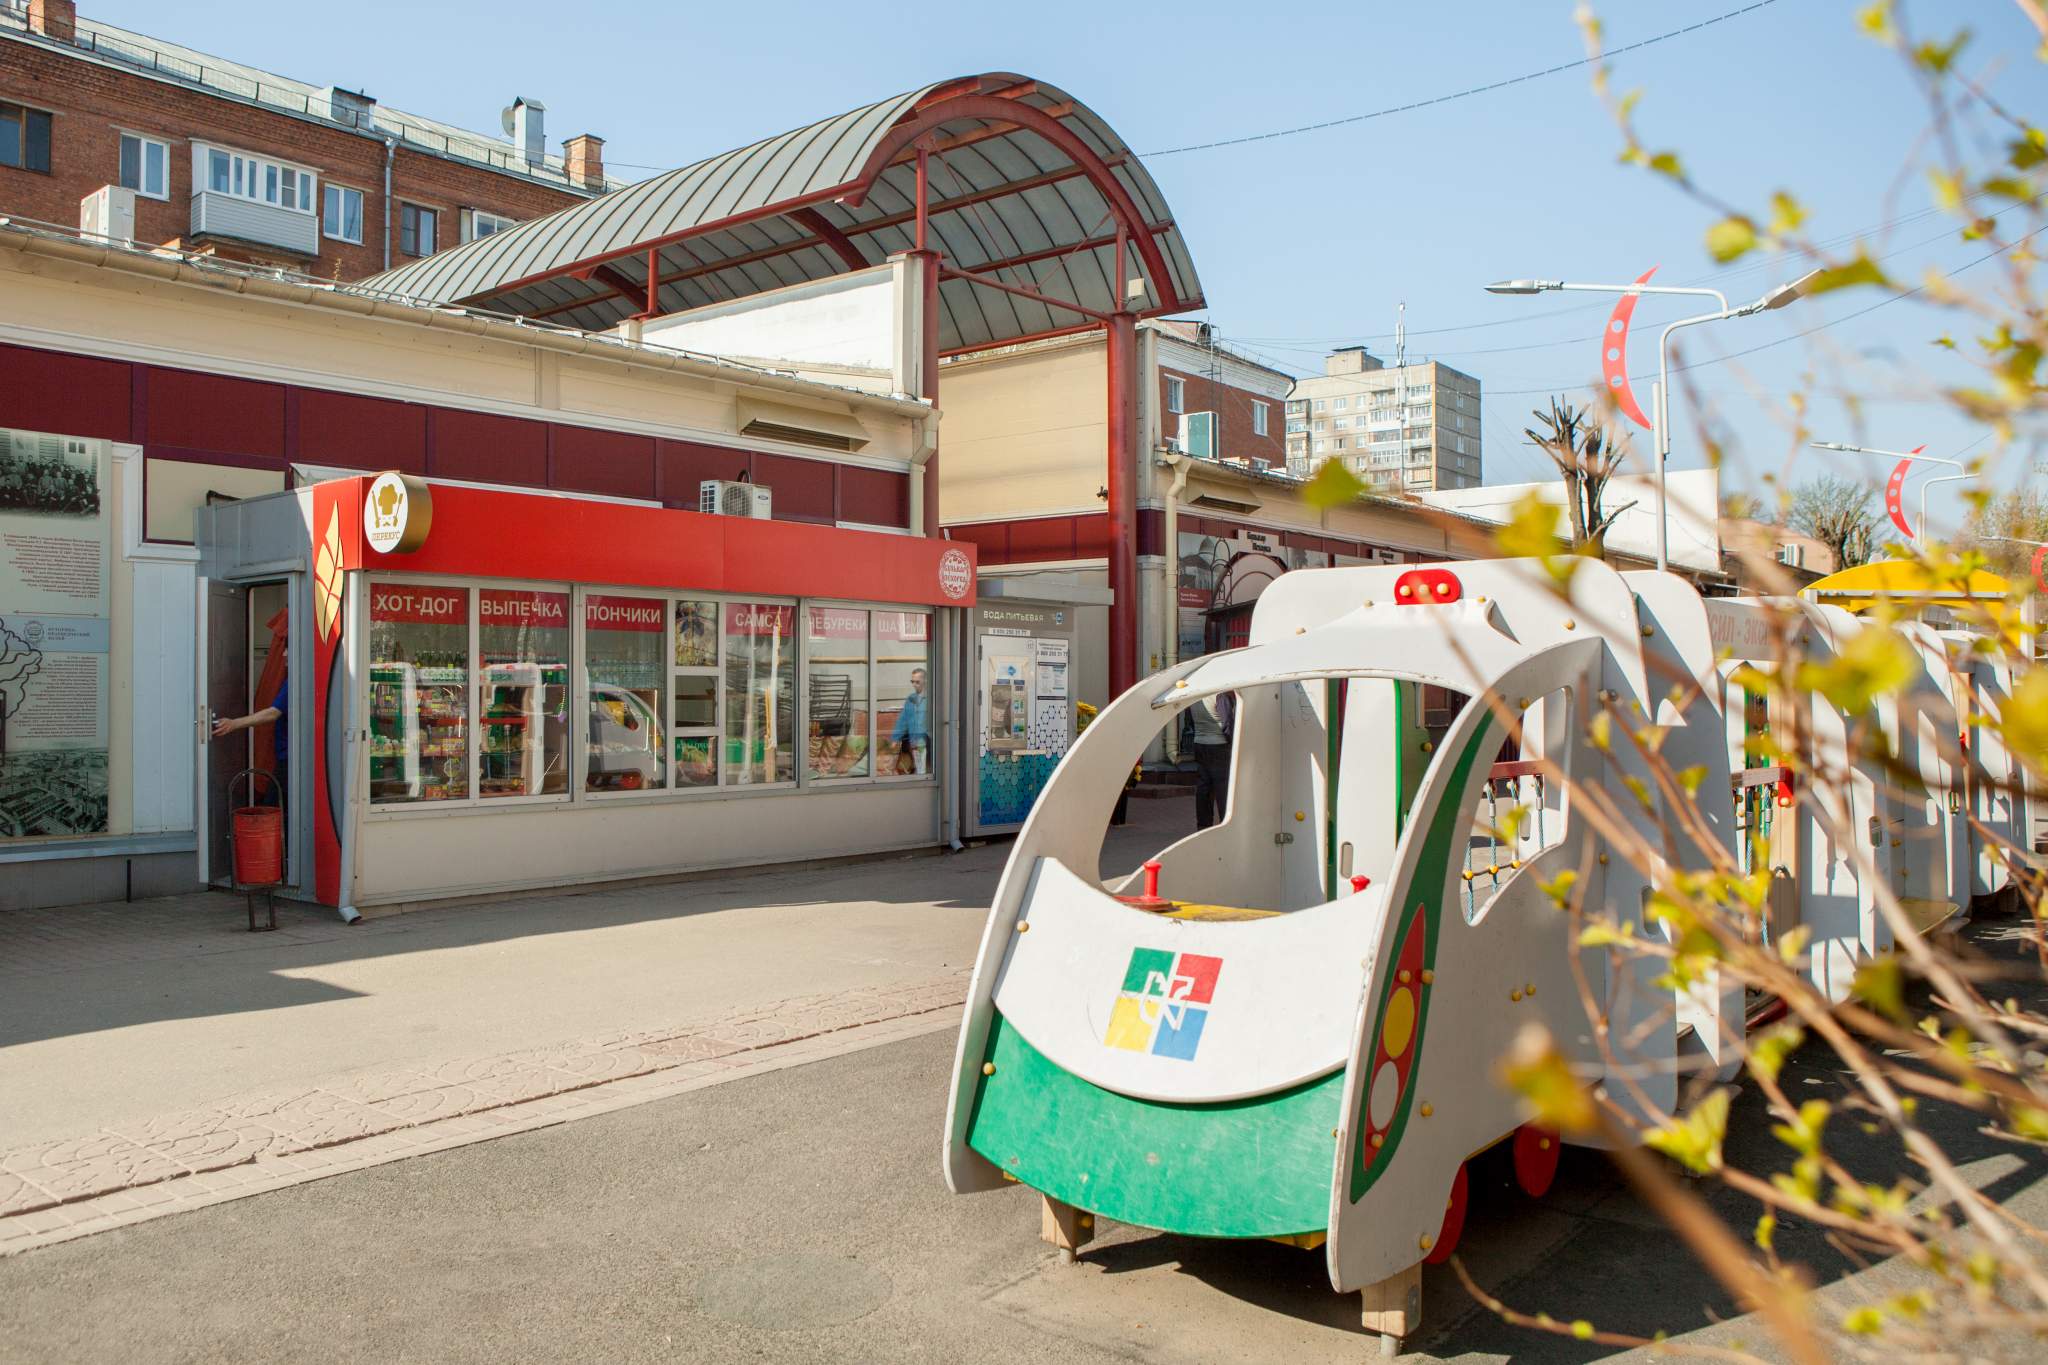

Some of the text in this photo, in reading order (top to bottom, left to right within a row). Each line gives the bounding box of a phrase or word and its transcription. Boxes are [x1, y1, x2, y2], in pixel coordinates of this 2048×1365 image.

[375, 594, 458, 616] ХОТ-ДОГ
[481, 600, 563, 618] ВЫПЕЧКА
[587, 605, 661, 623] ПОНЧИКИ
[735, 613, 782, 628] САМСА
[983, 610, 1044, 622] ВОДА ПИТЬЕВАЯ
